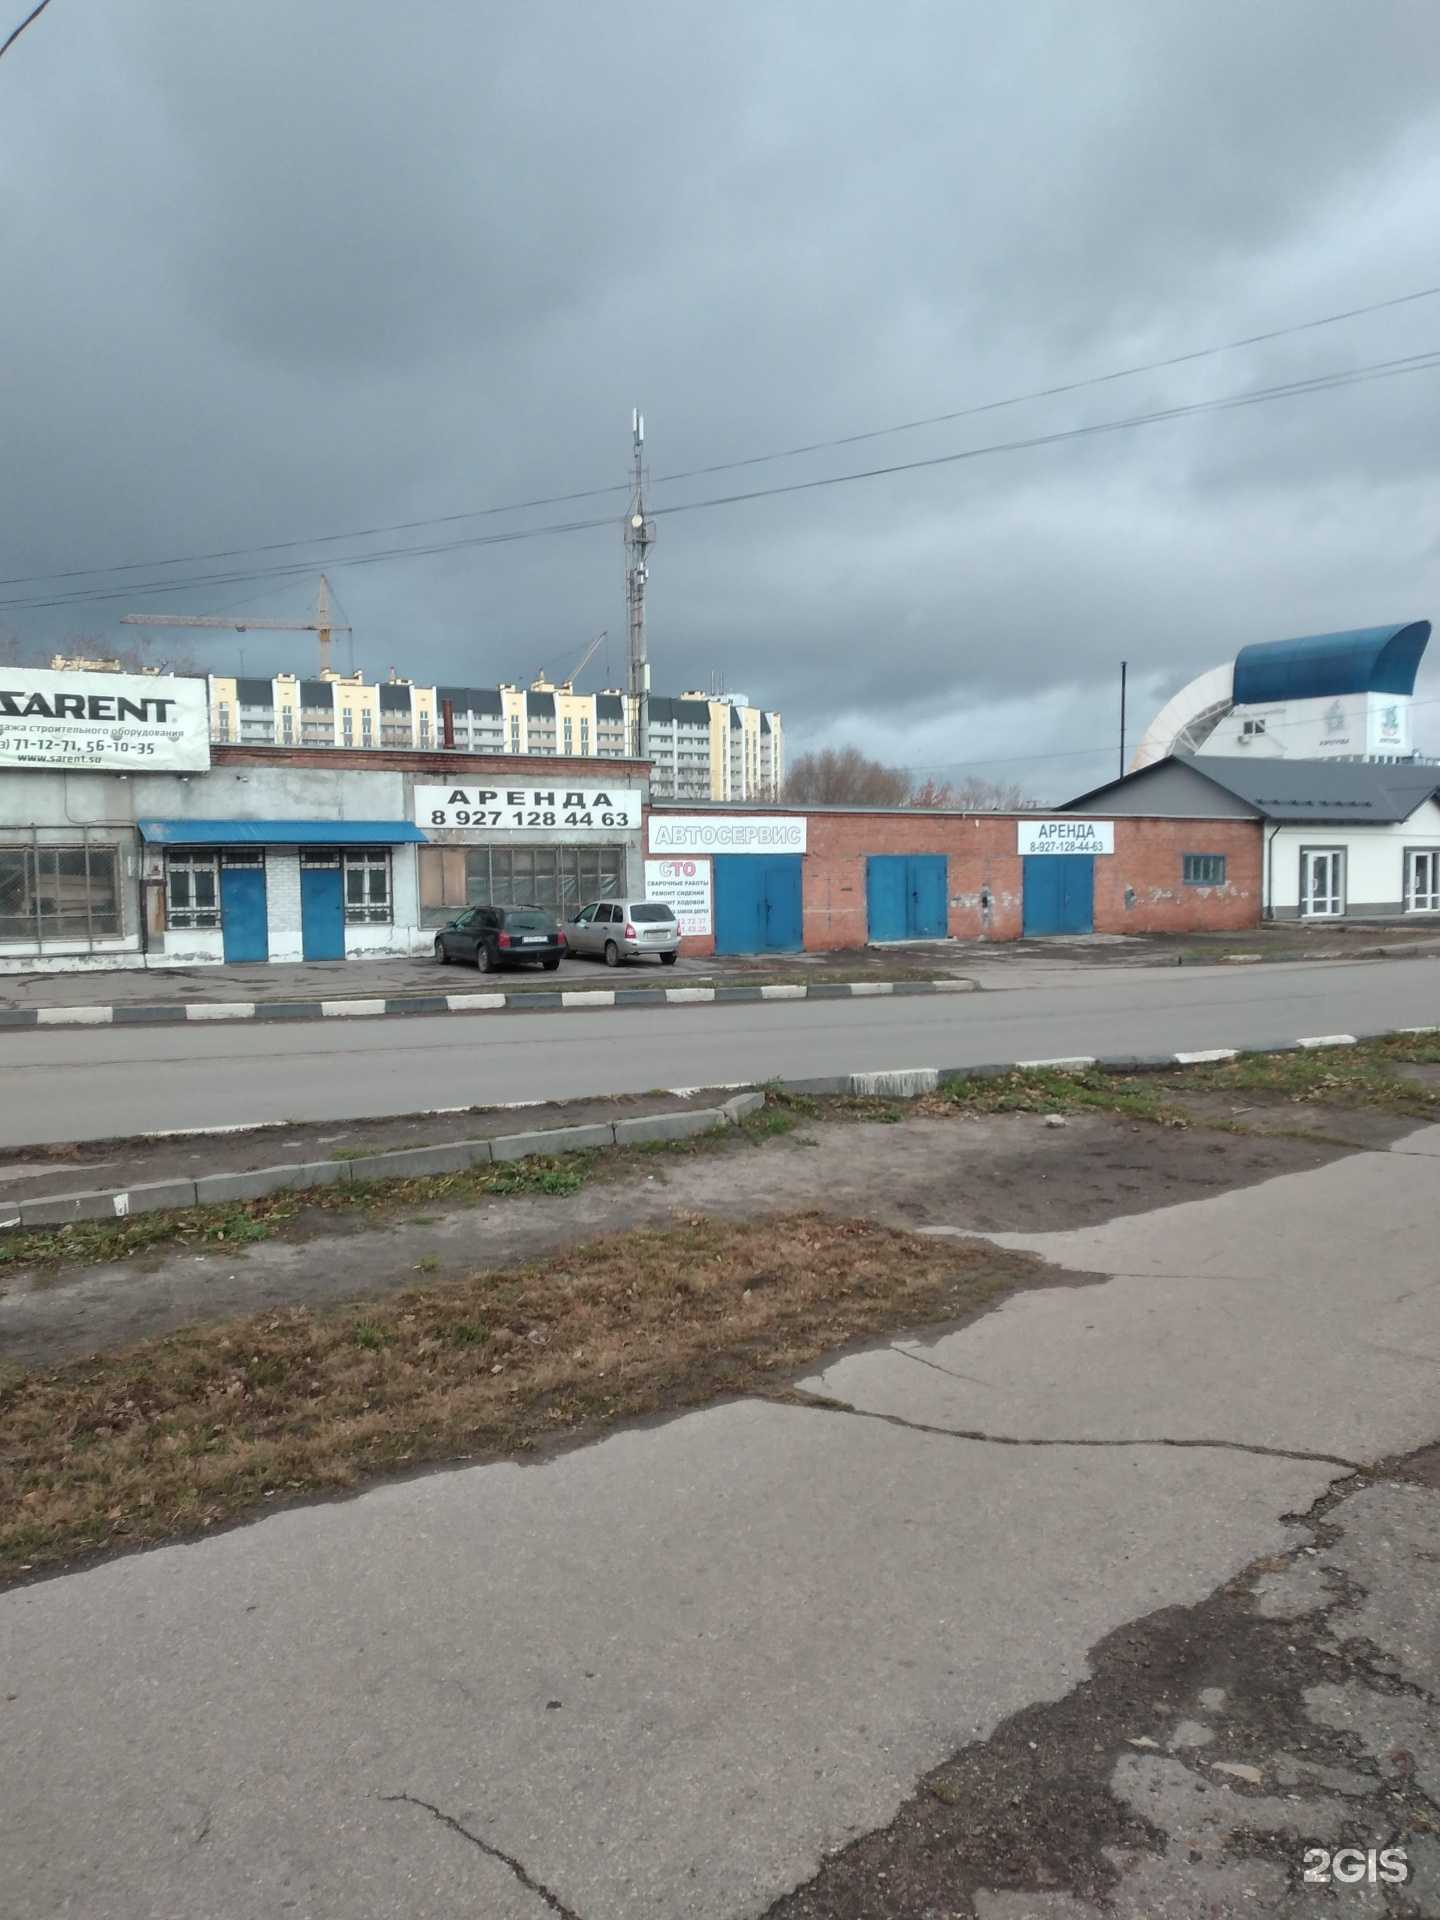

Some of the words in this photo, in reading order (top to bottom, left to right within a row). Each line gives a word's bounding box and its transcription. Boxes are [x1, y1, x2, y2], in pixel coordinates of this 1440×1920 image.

[29, 725, 109, 737] строительного
[111, 728, 184, 738] оборудования
[13, 738, 81, 752] 71-12-71,
[86, 740, 155, 754] 56-10-35
[17, 754, 102, 764] www.sarent.su
[447, 790, 613, 809] АРЕНДА
[431, 810, 446, 825] 8
[455, 811, 502, 826] 927
[512, 812, 556, 826] 128
[564, 812, 593, 826] 44
[601, 812, 629, 827] 63
[655, 825, 801, 845] АВТОСЕРВИС
[1039, 824, 1096, 841] АРЕНДА
[1030, 841, 1104, 852] 8-927-128-44-63
[659, 861, 697, 878] СТО
